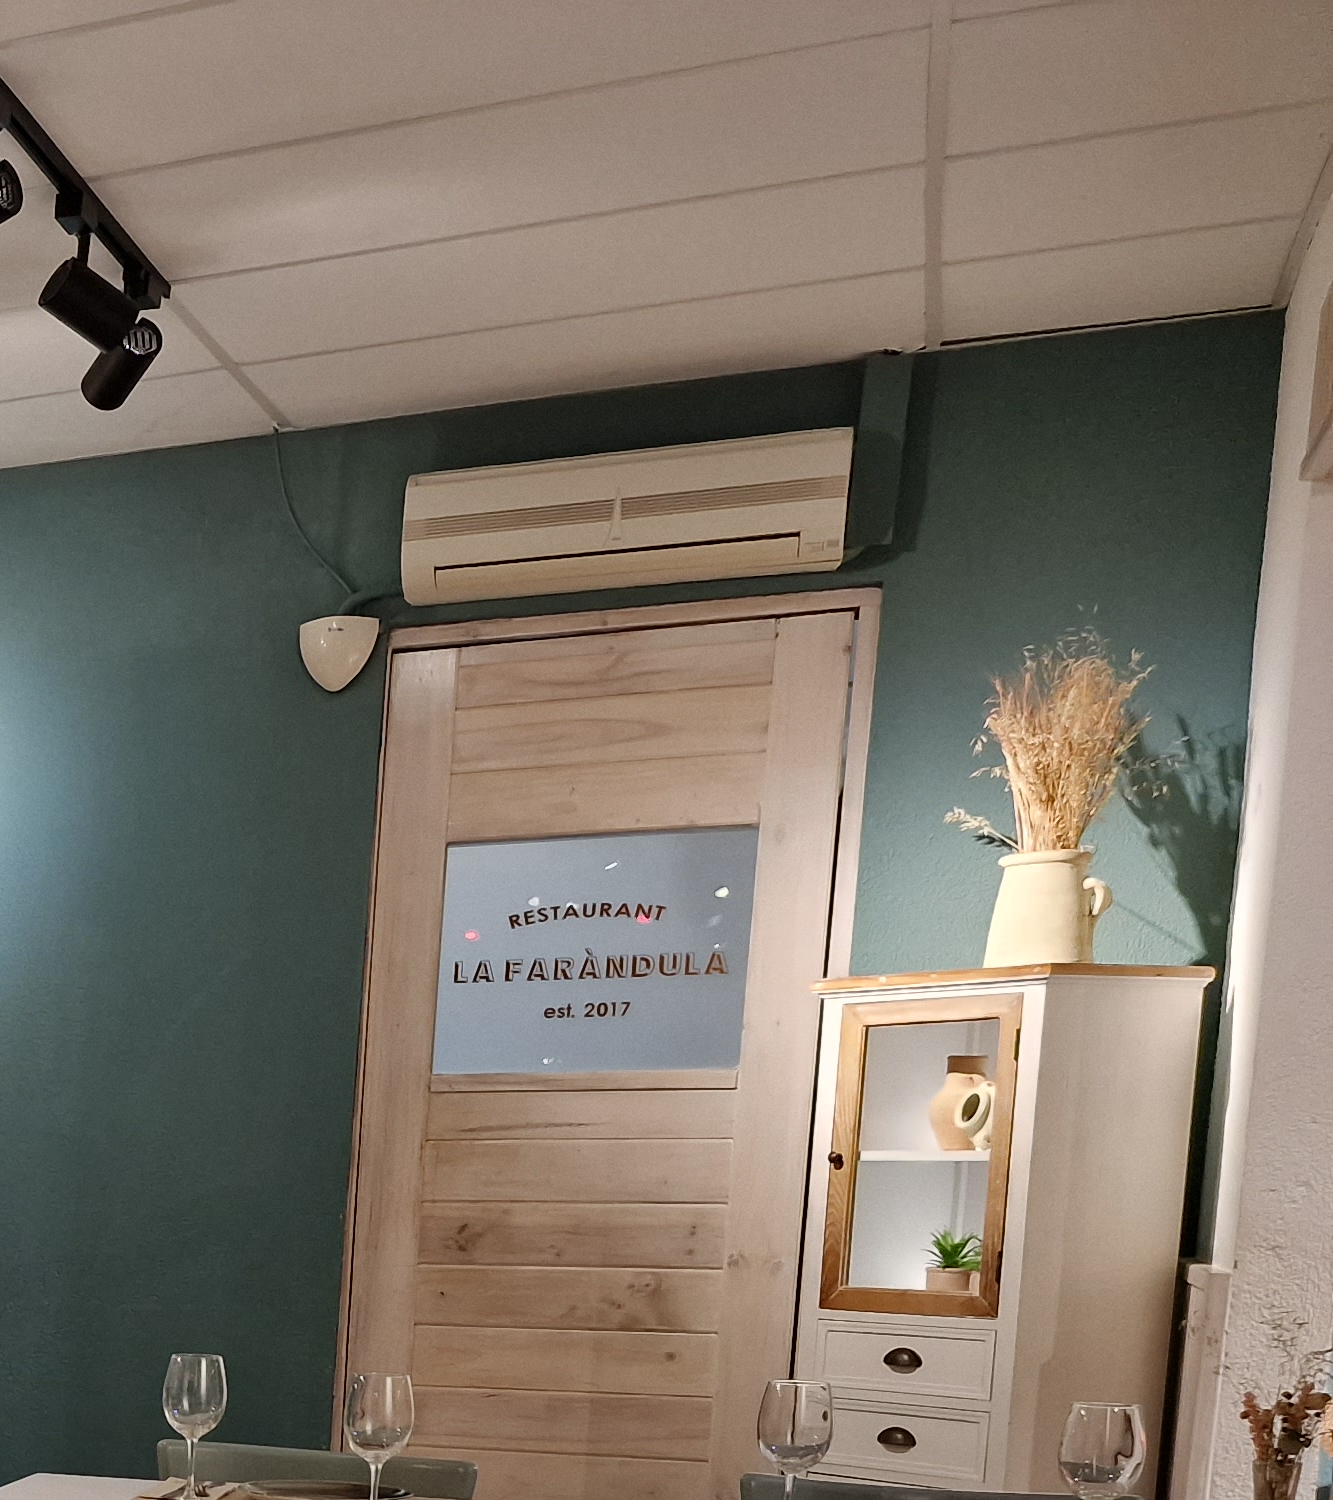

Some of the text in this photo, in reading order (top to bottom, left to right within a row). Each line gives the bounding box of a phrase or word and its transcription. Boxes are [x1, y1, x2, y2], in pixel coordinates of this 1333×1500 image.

[508, 902, 667, 929] RESTAURANT
[453, 948, 729, 984] LA FARÀNDULA
[543, 1002, 631, 1019] est. 2017
